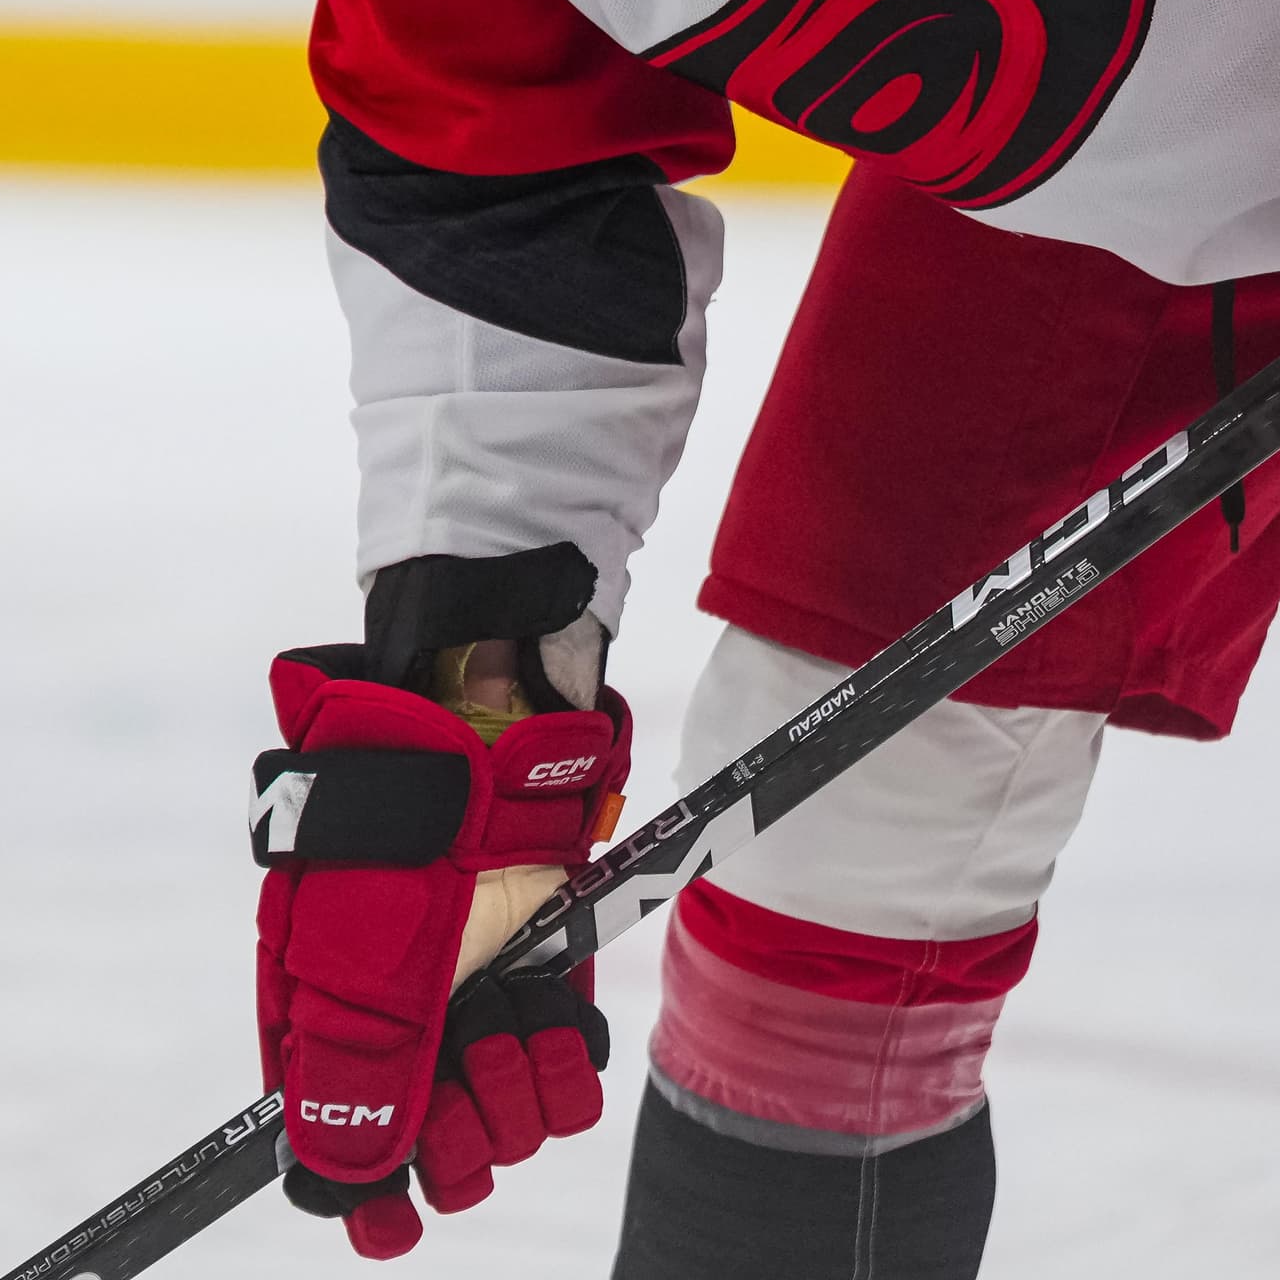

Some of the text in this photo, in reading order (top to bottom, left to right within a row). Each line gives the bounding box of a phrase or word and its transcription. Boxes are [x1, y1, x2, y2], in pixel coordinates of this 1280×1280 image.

[950, 429, 1190, 631] CCM
[990, 558, 1093, 636] NANOLITE
[995, 565, 1100, 647] SHIELD
[788, 683, 856, 742] NADEAU
[528, 754, 597, 780] CCM
[300, 1100, 395, 1126] CCM
